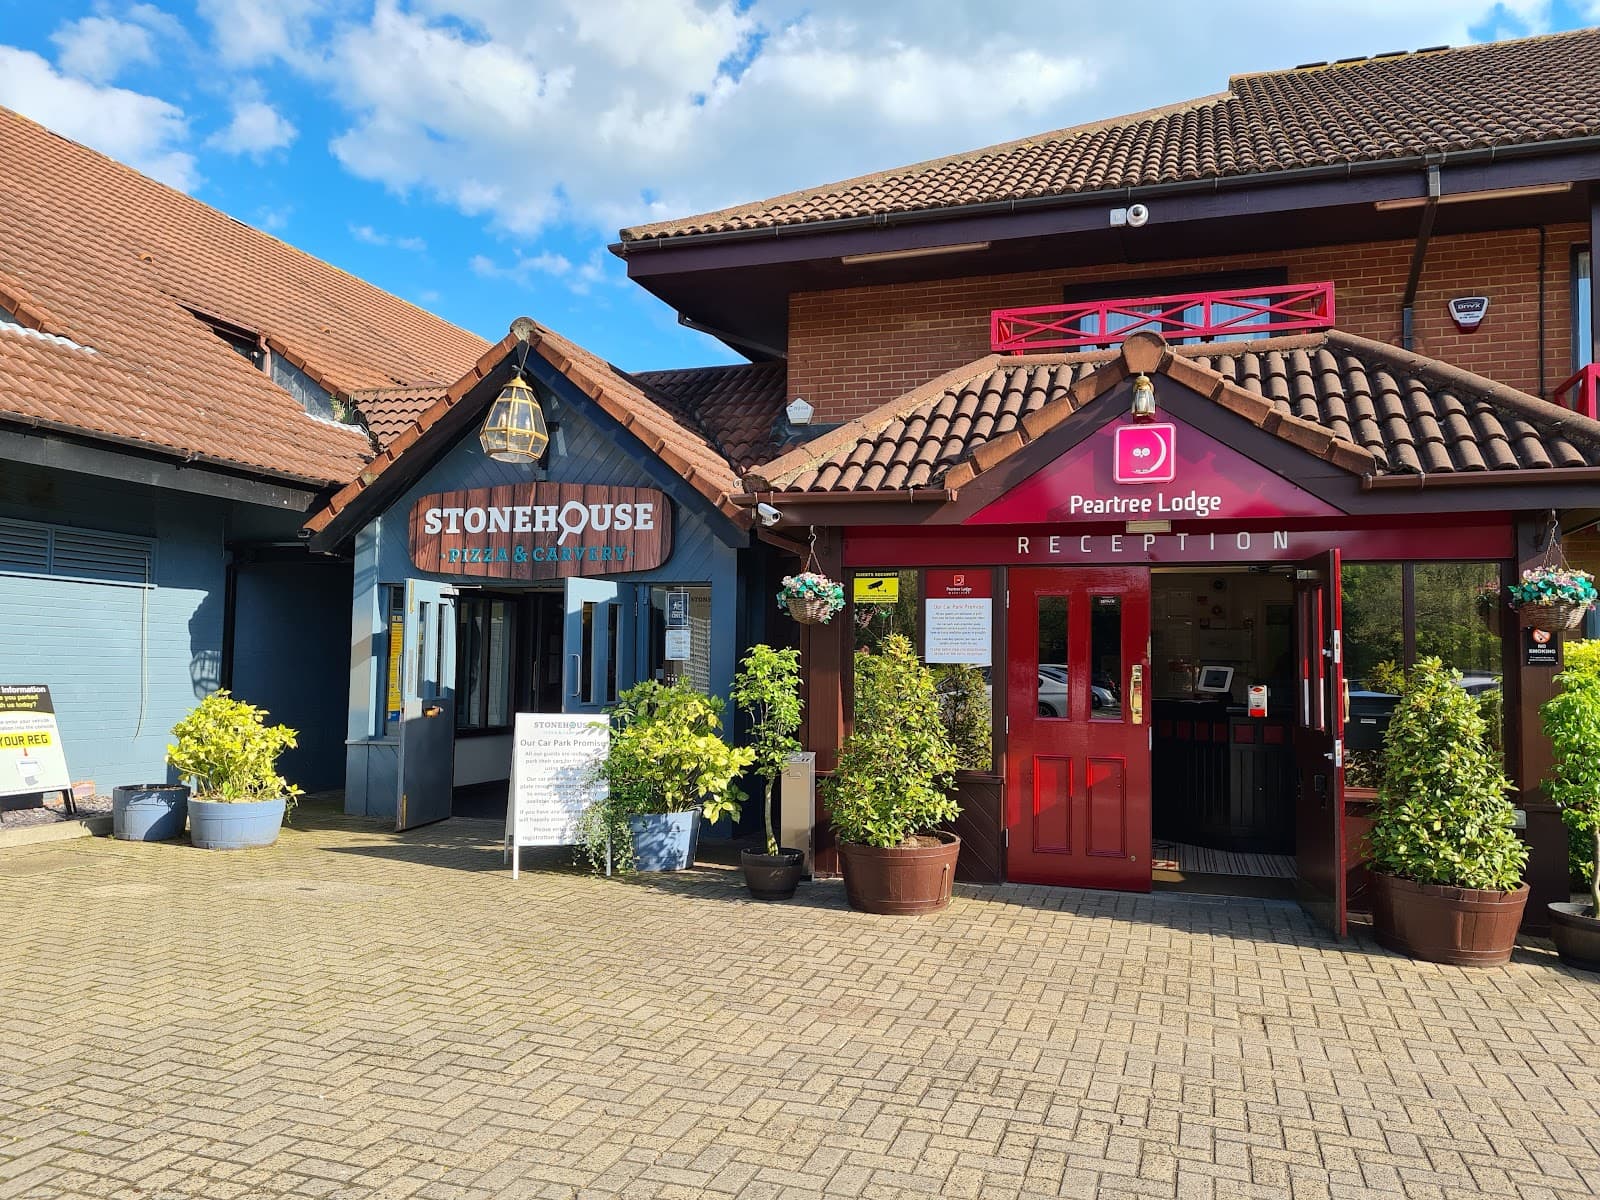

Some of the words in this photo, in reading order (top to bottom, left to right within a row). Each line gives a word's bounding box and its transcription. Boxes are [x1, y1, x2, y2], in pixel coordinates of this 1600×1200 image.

[1070, 495, 1152, 514] Peartree
[1158, 490, 1222, 517] Lodge
[424, 500, 654, 546] STONEHOUSE
[1017, 531, 1288, 553] RECEPTION
[448, 548, 509, 563] PIZZA
[513, 544, 528, 563] &
[532, 546, 627, 562] CARVERY
[534, 721, 590, 729] STONEHOUS
[27, 734, 48, 745] REG
[520, 739, 536, 747] Our
[537, 739, 551, 747] Car
[553, 739, 571, 747] Park
